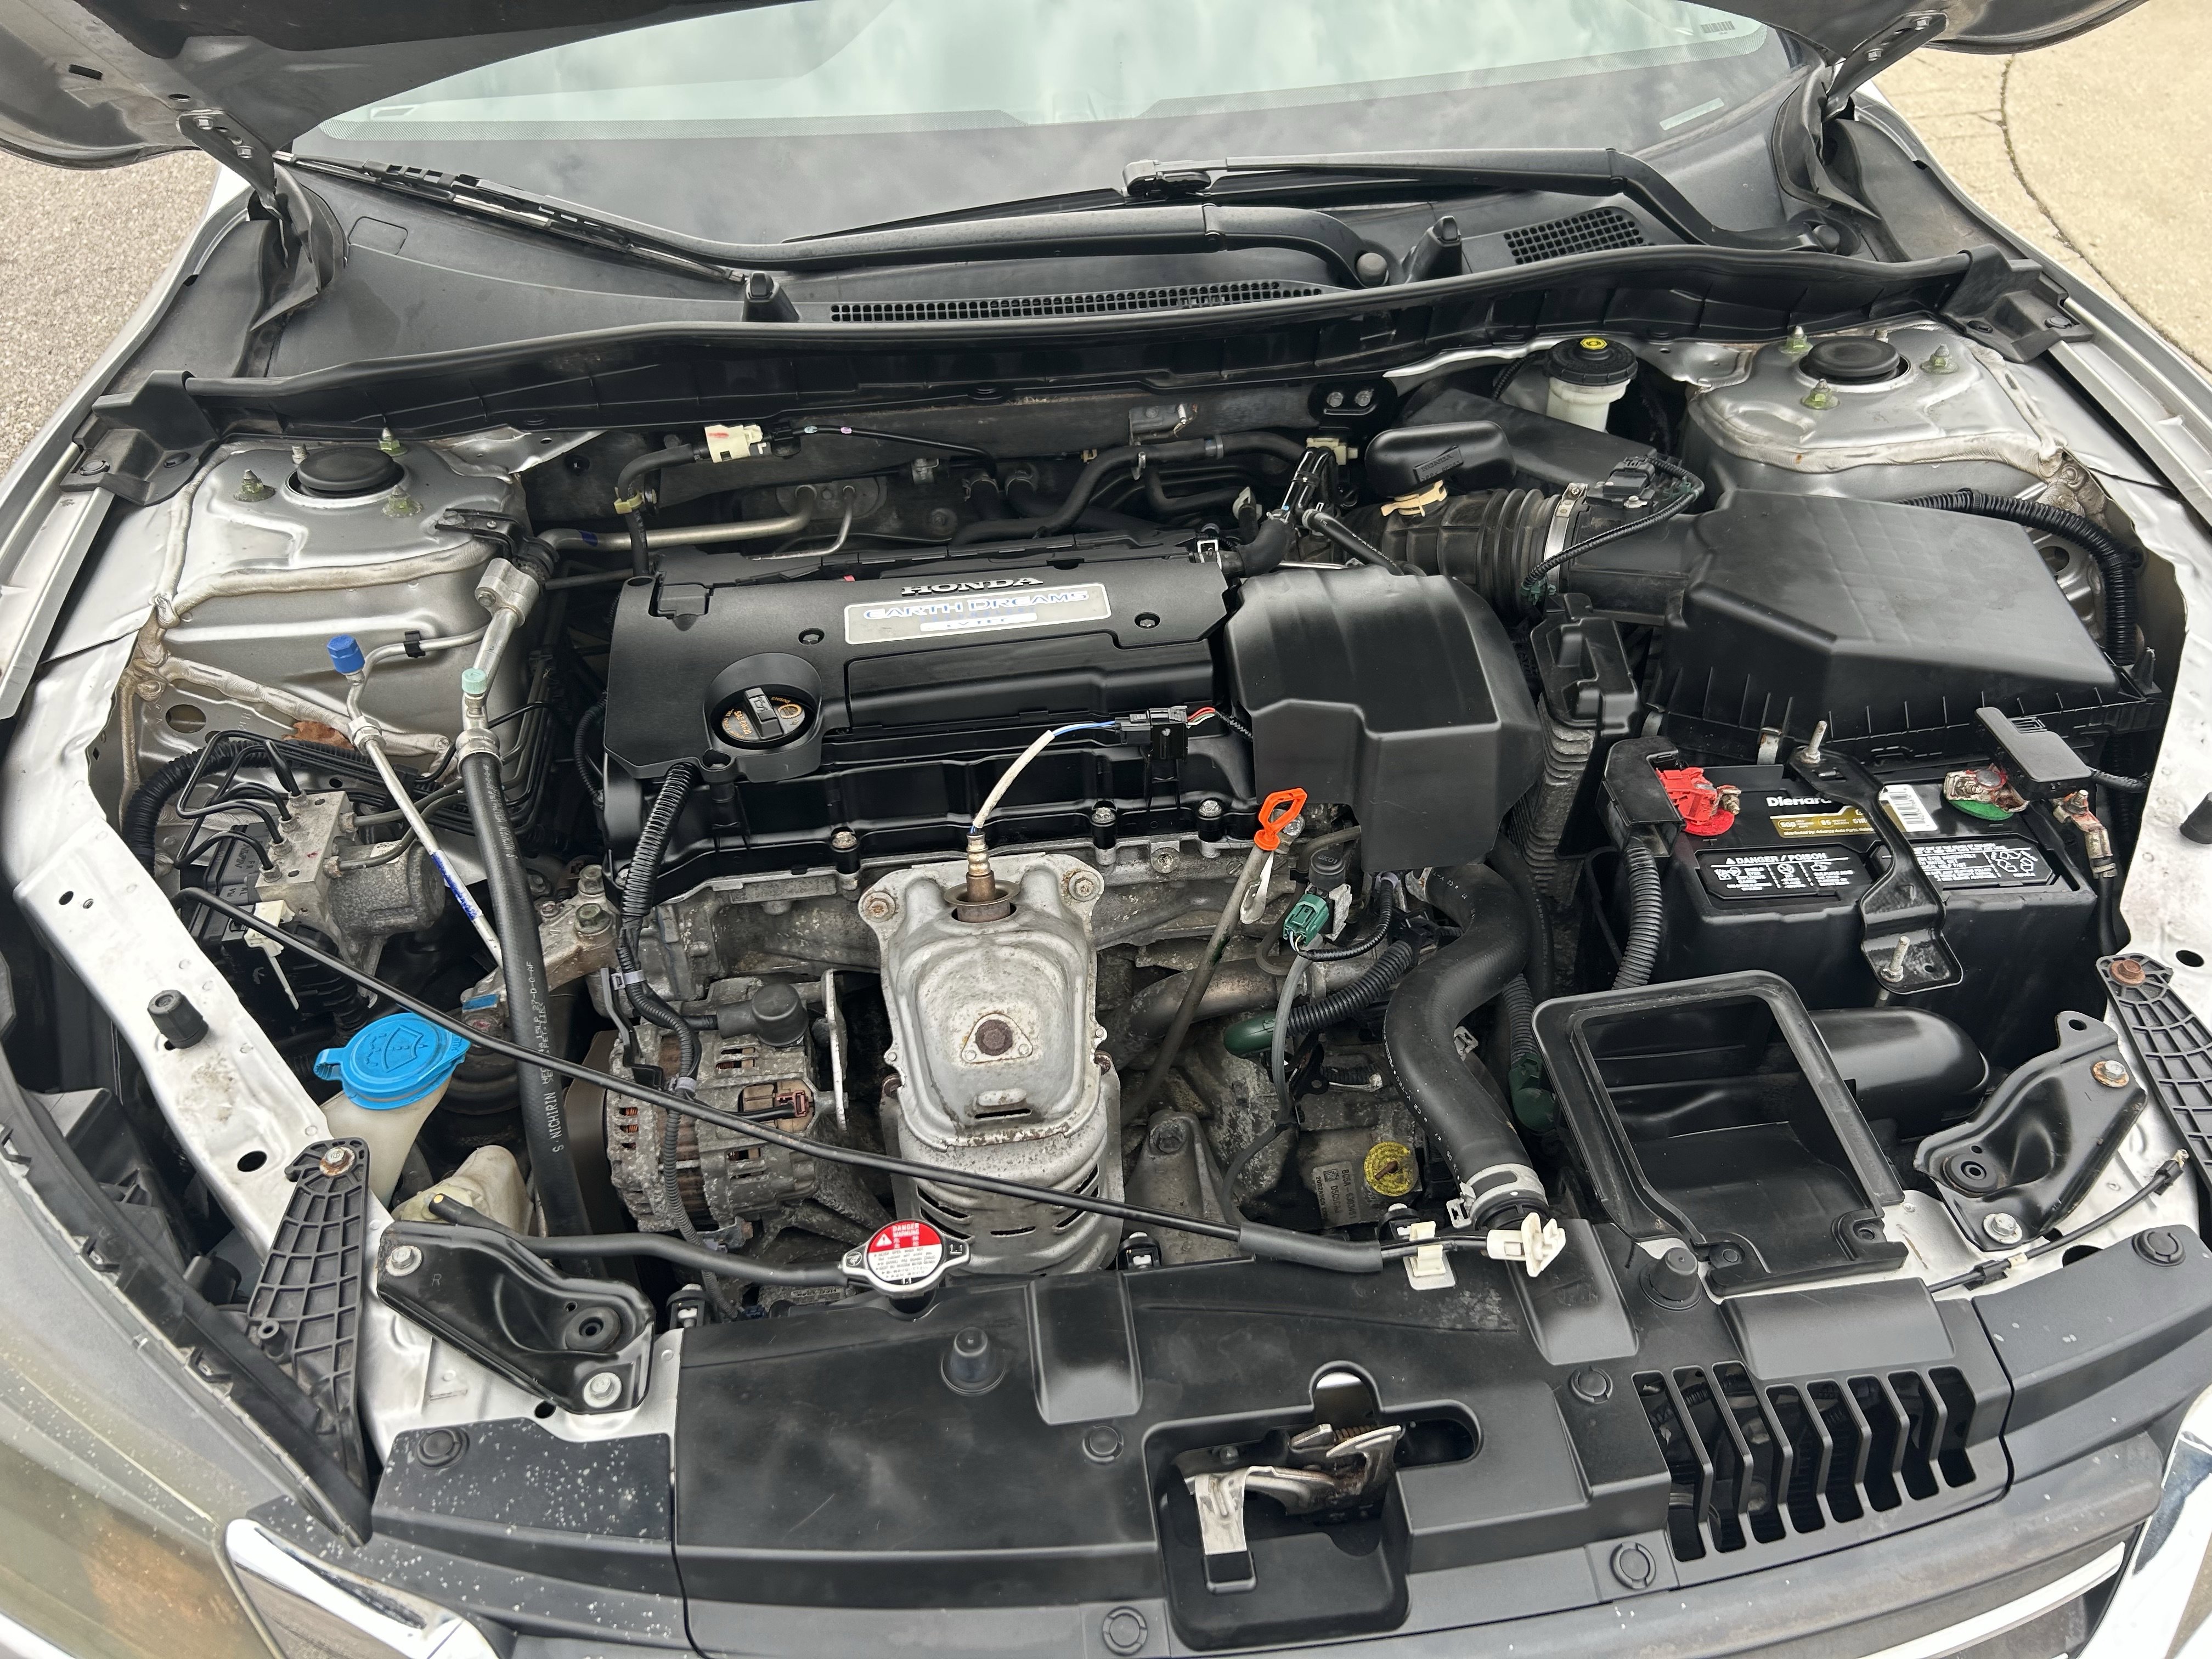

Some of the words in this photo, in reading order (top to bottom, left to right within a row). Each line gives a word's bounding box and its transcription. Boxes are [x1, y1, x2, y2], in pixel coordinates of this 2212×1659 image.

[901, 577, 1043, 596] HONDA
[864, 601, 964, 620] EARTH
[970, 590, 1090, 612] DREAMS
[1735, 855, 1780, 864] DANGER
[1788, 852, 1827, 861] POISON
[893, 1222, 919, 1232] DANGER
[432, 1273, 442, 1286] R
